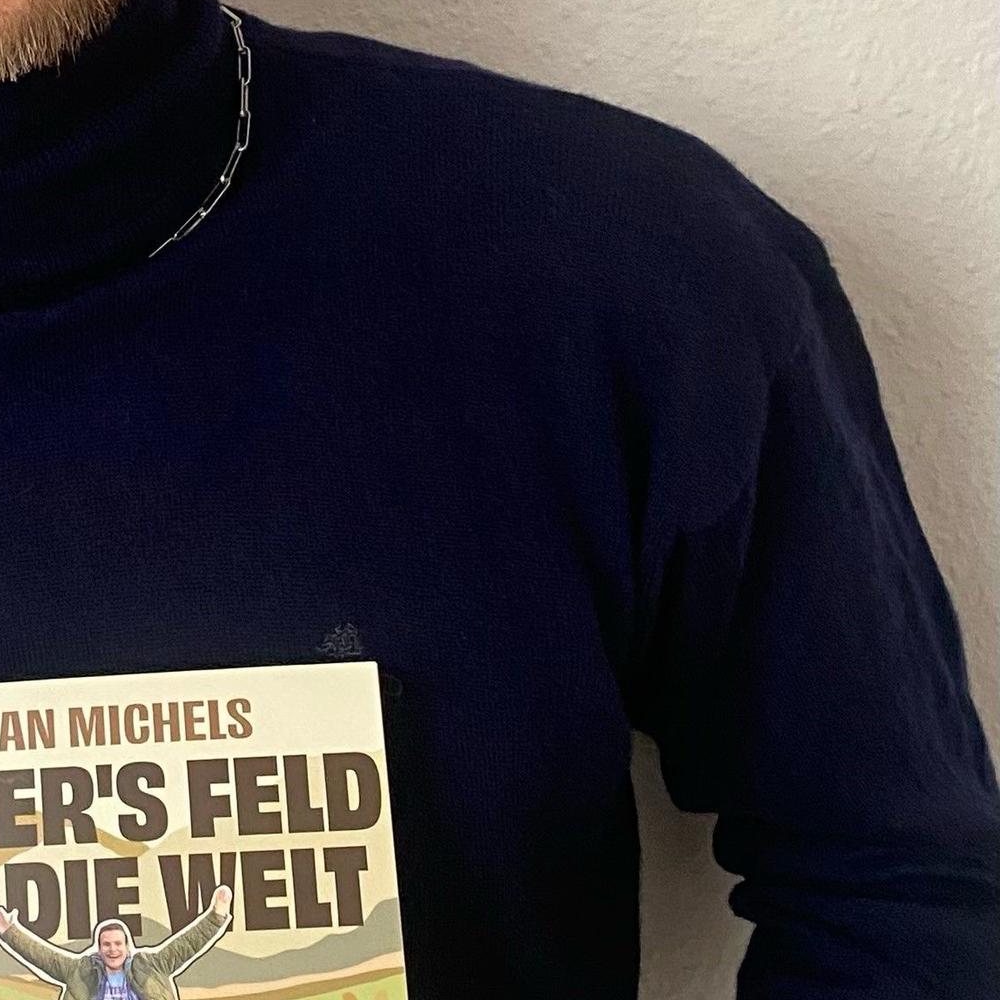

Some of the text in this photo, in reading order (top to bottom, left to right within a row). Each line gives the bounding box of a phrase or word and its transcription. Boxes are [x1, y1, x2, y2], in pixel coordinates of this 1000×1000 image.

[69, 698, 254, 747] MICHELS
[186, 751, 383, 839] FELD
[4, 857, 143, 940] DIE
[159, 845, 369, 933] WELT
